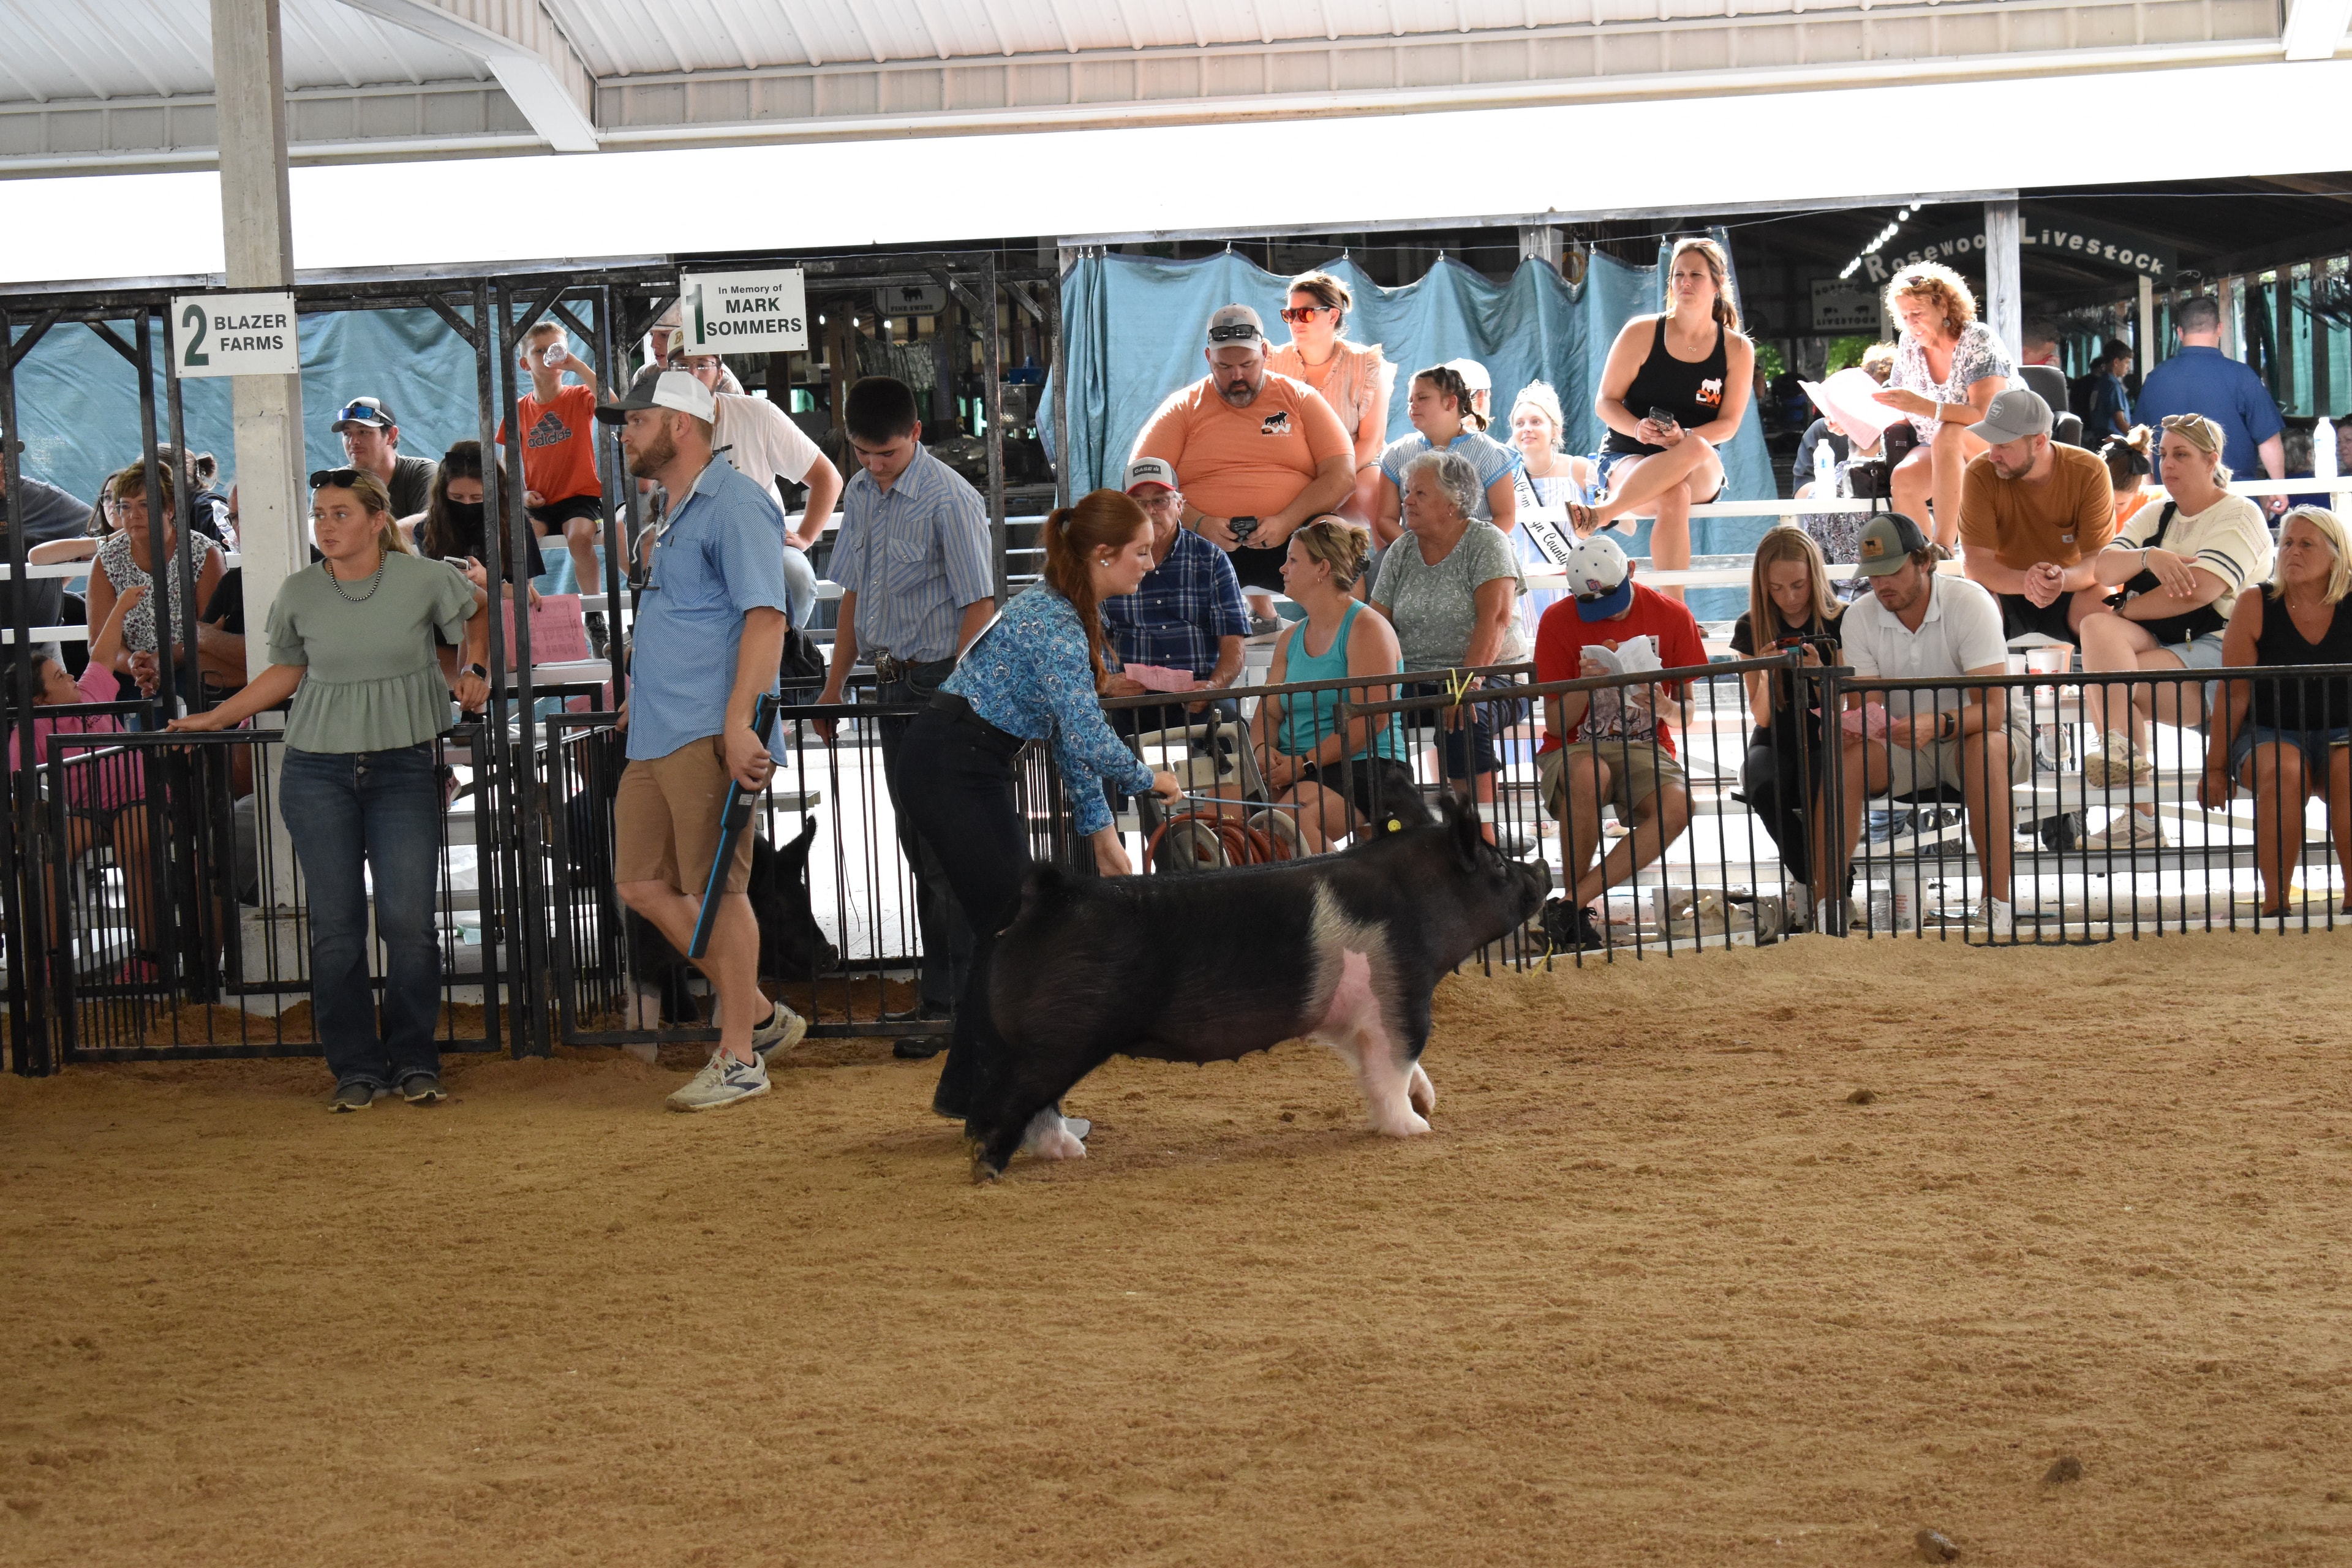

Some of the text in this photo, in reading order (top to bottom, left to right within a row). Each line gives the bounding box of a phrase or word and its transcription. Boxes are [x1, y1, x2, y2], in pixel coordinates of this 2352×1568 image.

[1864, 217, 2164, 282] Rosewoo Livestock
[686, 284, 705, 344] 1
[726, 297, 780, 314] MARK
[214, 314, 287, 330] BLAZER
[706, 318, 802, 336] SOMMERS
[182, 304, 209, 366] 2
[221, 336, 284, 352] FARMS
[528, 427, 573, 448] adidas
